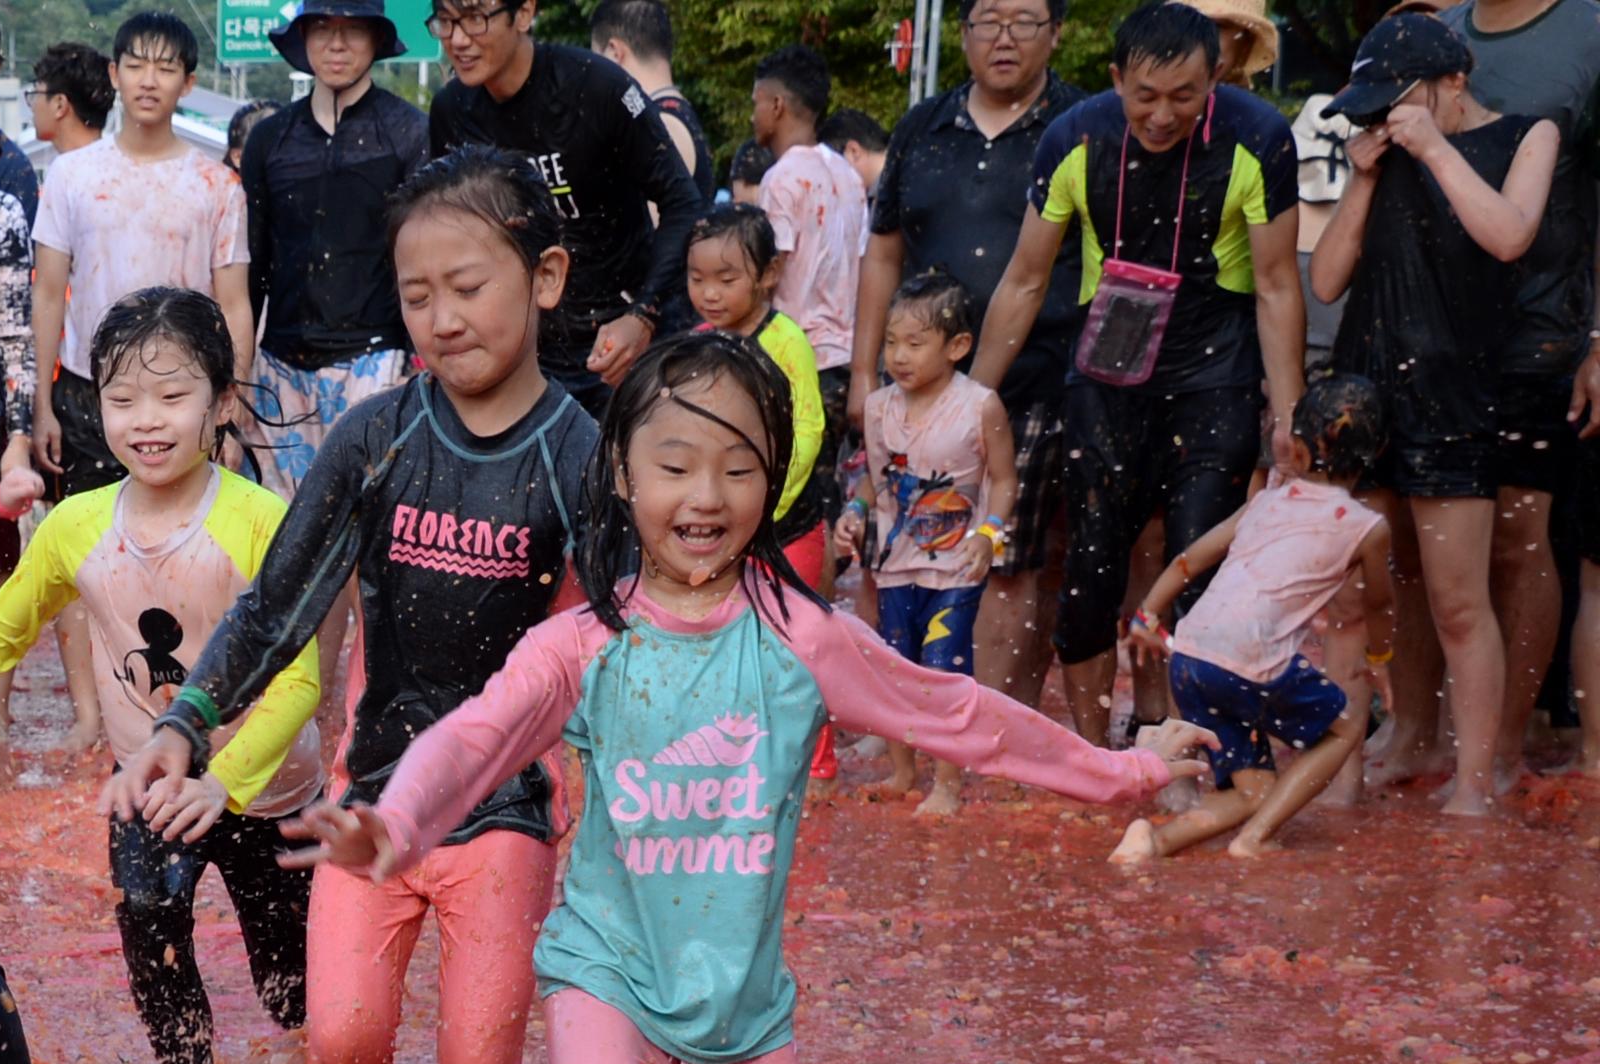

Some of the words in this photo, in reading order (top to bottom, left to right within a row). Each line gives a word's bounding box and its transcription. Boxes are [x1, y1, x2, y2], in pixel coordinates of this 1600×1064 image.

[392, 504, 531, 559] FLORENCE
[609, 758, 772, 823] Sweet
[615, 833, 776, 876] umme
